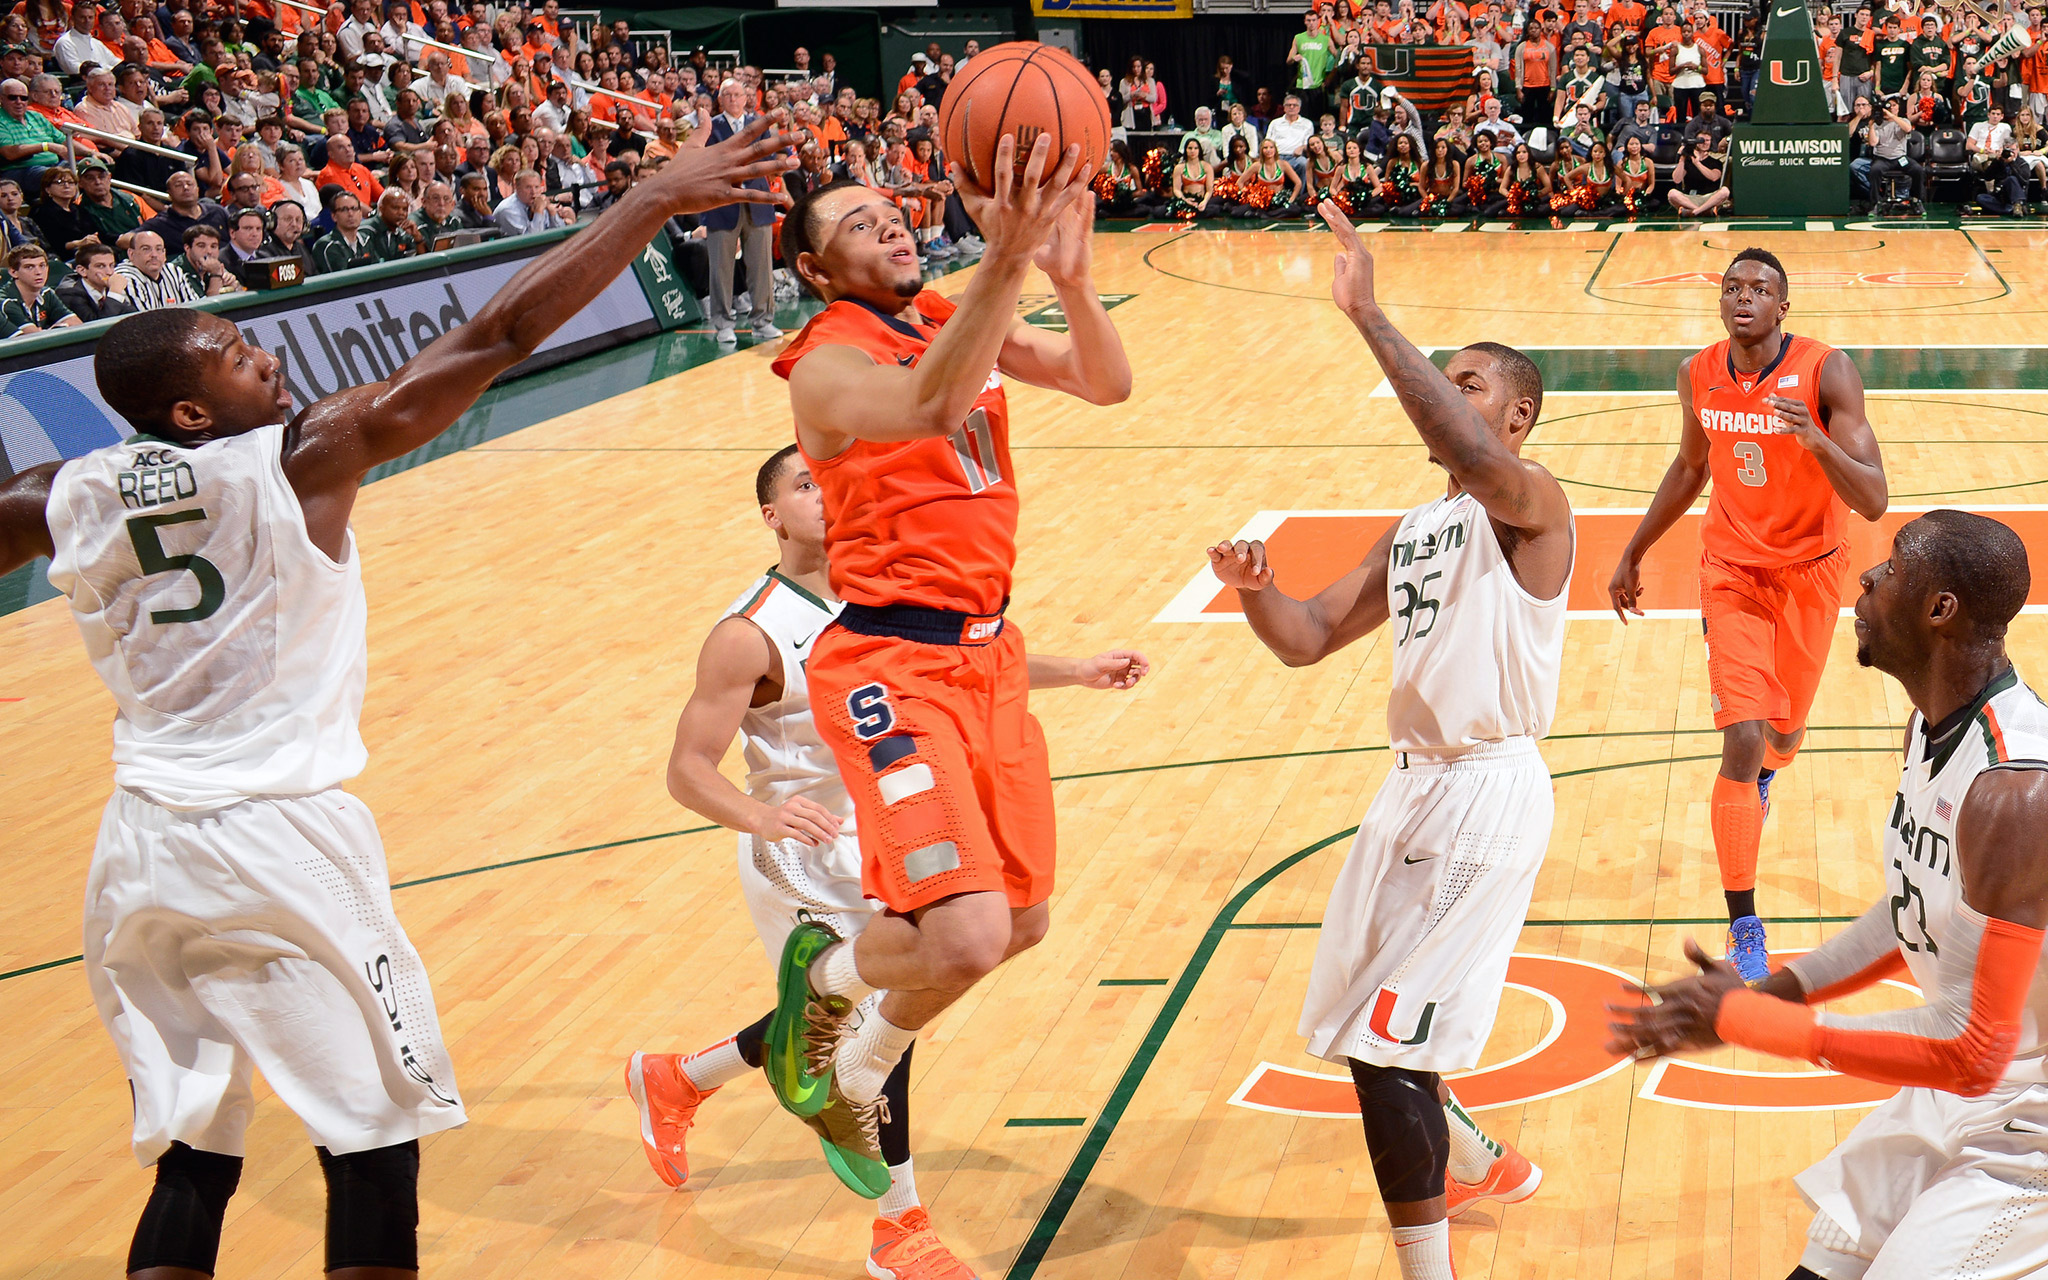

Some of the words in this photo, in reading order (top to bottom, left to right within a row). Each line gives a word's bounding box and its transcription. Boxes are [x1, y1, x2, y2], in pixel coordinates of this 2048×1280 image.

[1364, 46, 1410, 76] U
[1979, 32, 2021, 67] MIAMI
[1770, 60, 1810, 86] U
[1352, 94, 1376, 111] U
[1739, 140, 1842, 154] WILLIAMSON
[1740, 156, 1775, 167] Cadillac
[1779, 157, 1805, 166] BUICK
[1808, 156, 1842, 166] GMC
[278, 263, 297, 282] POSS
[1700, 408, 1787, 435] SYRACUS
[132, 450, 173, 468] ACC
[945, 405, 1003, 495] 11
[1733, 441, 1767, 487] 3
[119, 461, 198, 508] REED
[126, 507, 226, 625] 5
[1394, 570, 1443, 648] 35
[845, 681, 898, 740] S
[1365, 983, 1438, 1046] U
